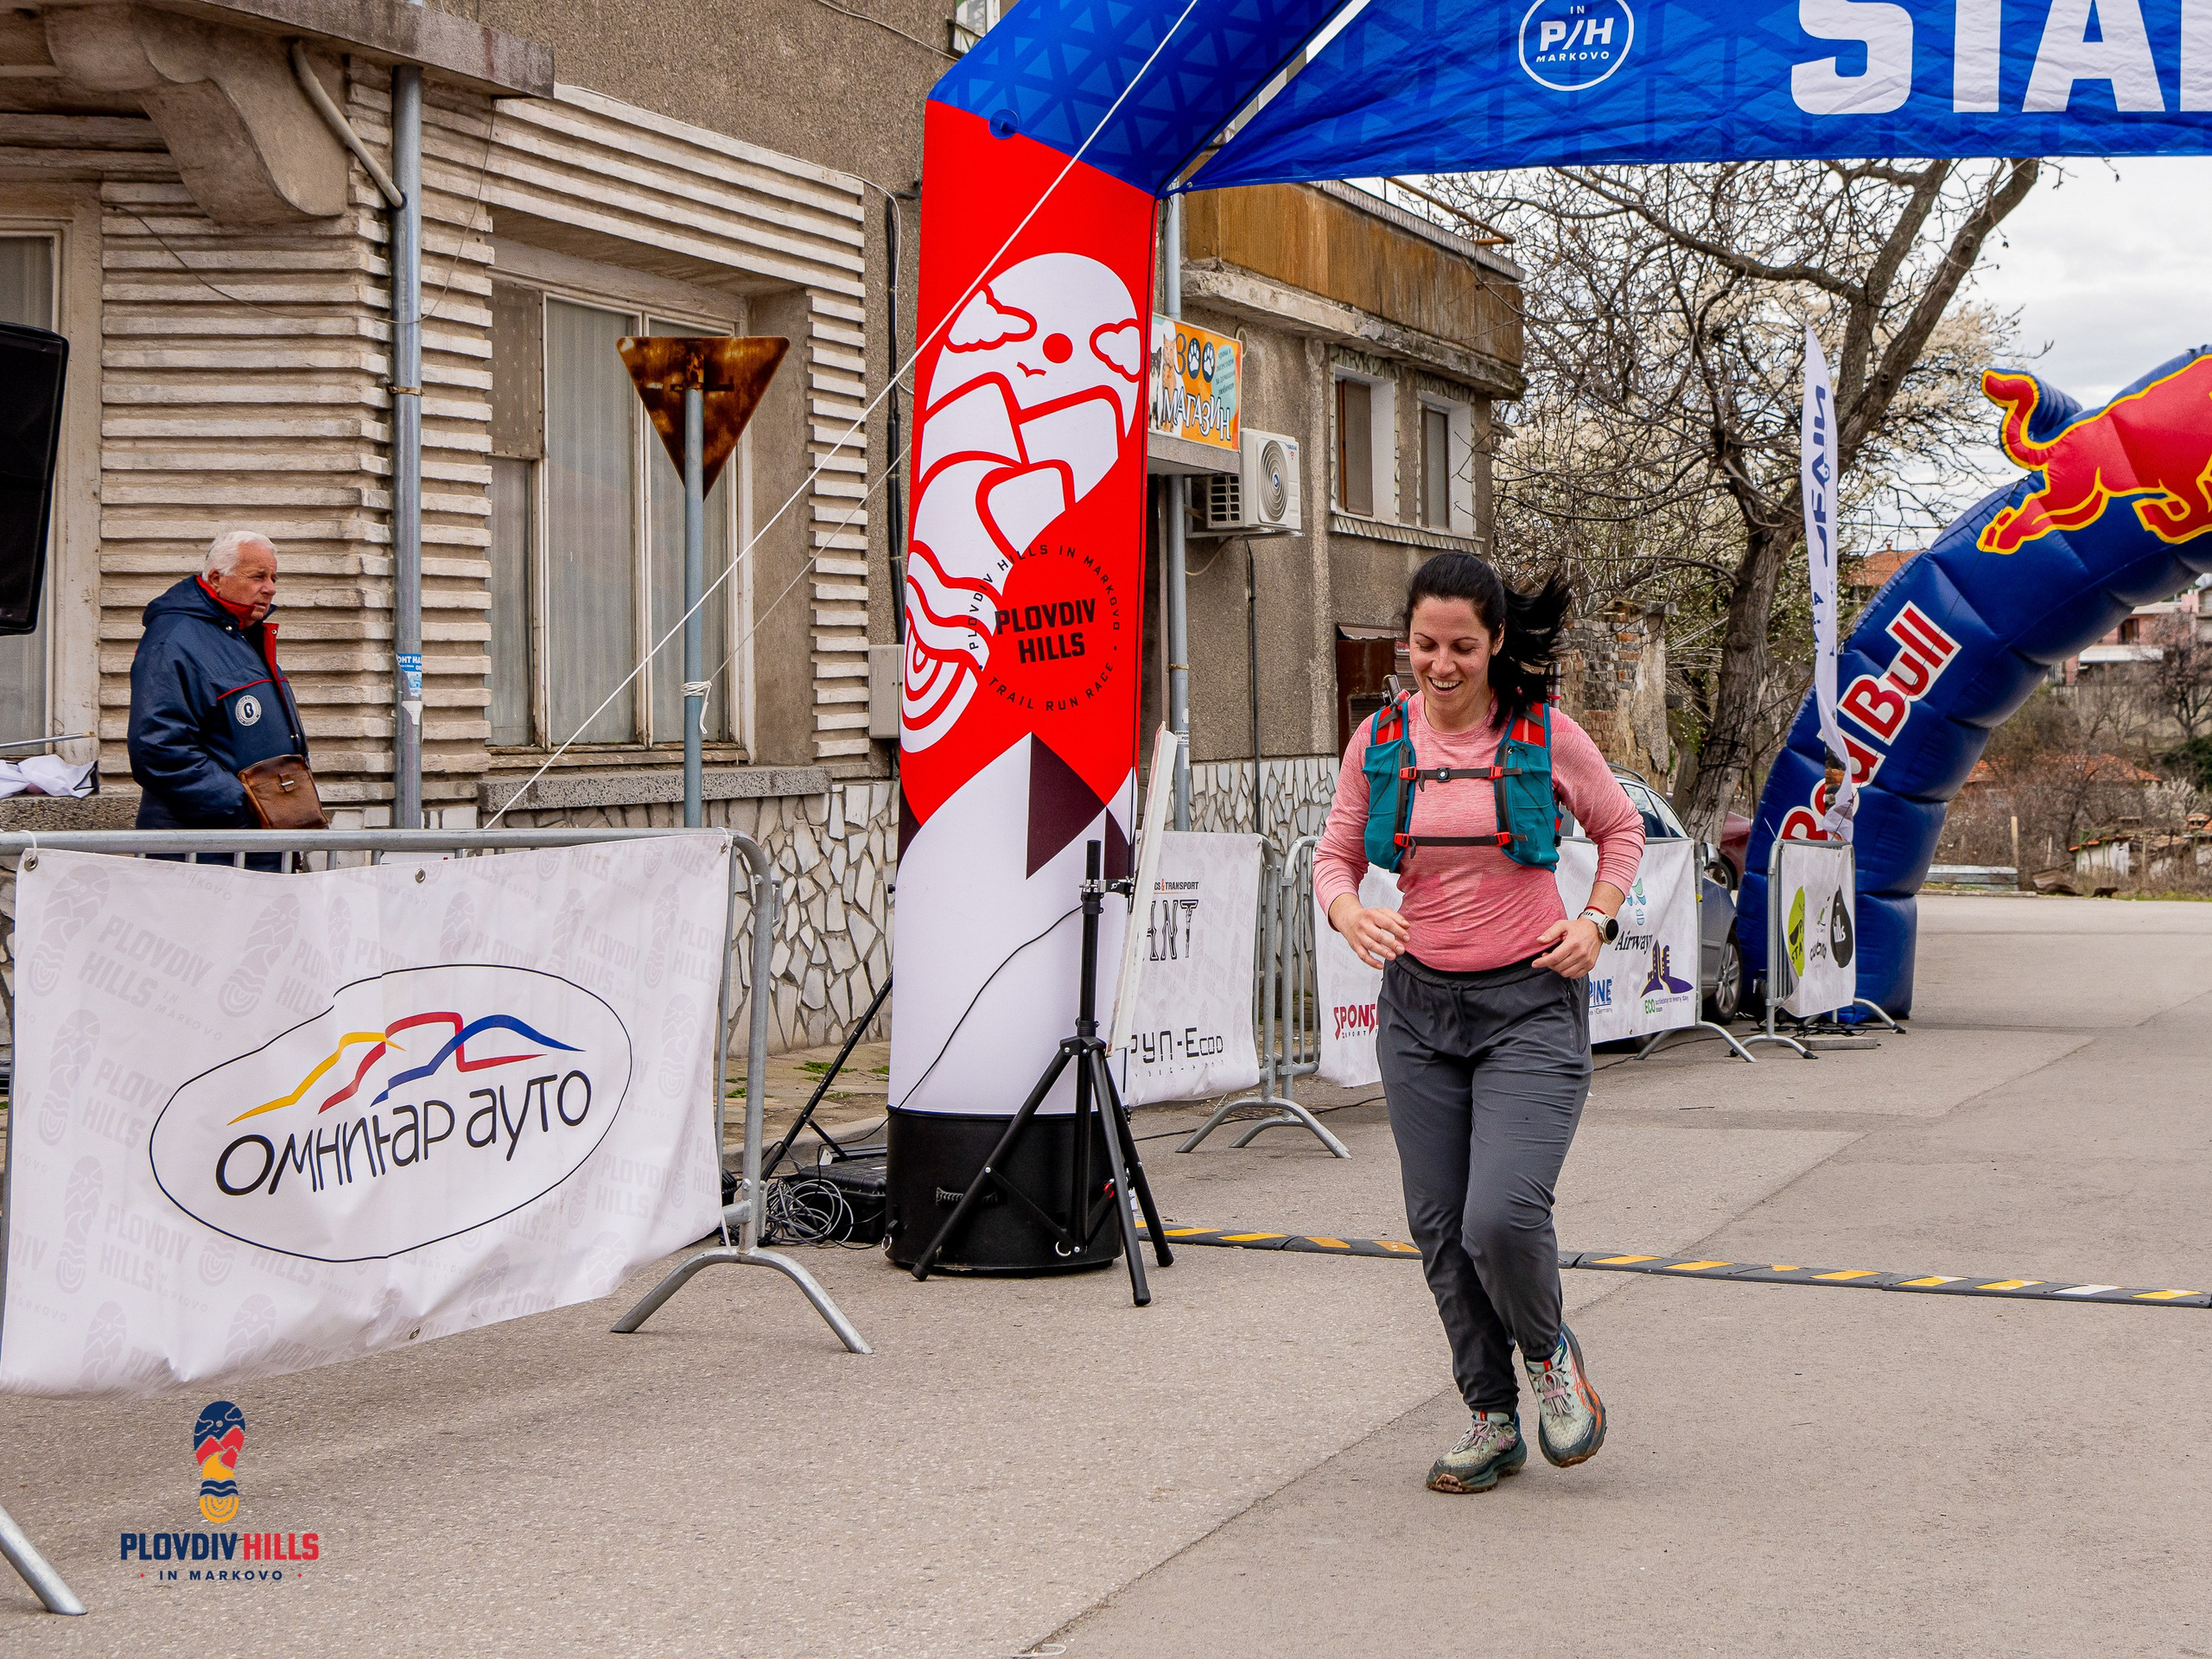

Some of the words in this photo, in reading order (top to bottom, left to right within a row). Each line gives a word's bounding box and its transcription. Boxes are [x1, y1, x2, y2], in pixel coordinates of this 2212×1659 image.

[1539, 17, 1615, 52] P/H
[1570, 5, 1586, 15] IN
[1535, 51, 1610, 63] MARKOVO
[1162, 386, 1231, 442] МАГАЗИН
[968, 573, 994, 651] PLOVDIV
[997, 543, 1048, 572] HILLS
[1059, 545, 1076, 558] IN
[1084, 556, 1120, 631] MARKOVO
[995, 598, 1096, 635] PLOVDIV
[1018, 632, 1085, 664] HILLS
[988, 677, 1034, 709] TRAIL
[1046, 696, 1079, 712] RUN
[1085, 663, 1114, 699] RACE
[1781, 734, 1879, 841] Rd
[1841, 607, 1955, 740] Bull
[98, 914, 215, 988] PLOVDIV
[77, 950, 158, 1008] HILLS
[1333, 1003, 1380, 1041] SPONS
[1644, 998, 1656, 1014] ECO
[81, 1096, 147, 1149] HILLS
[105, 1203, 194, 1264] PLOVDIV
[99, 1242, 155, 1292] HILLS
